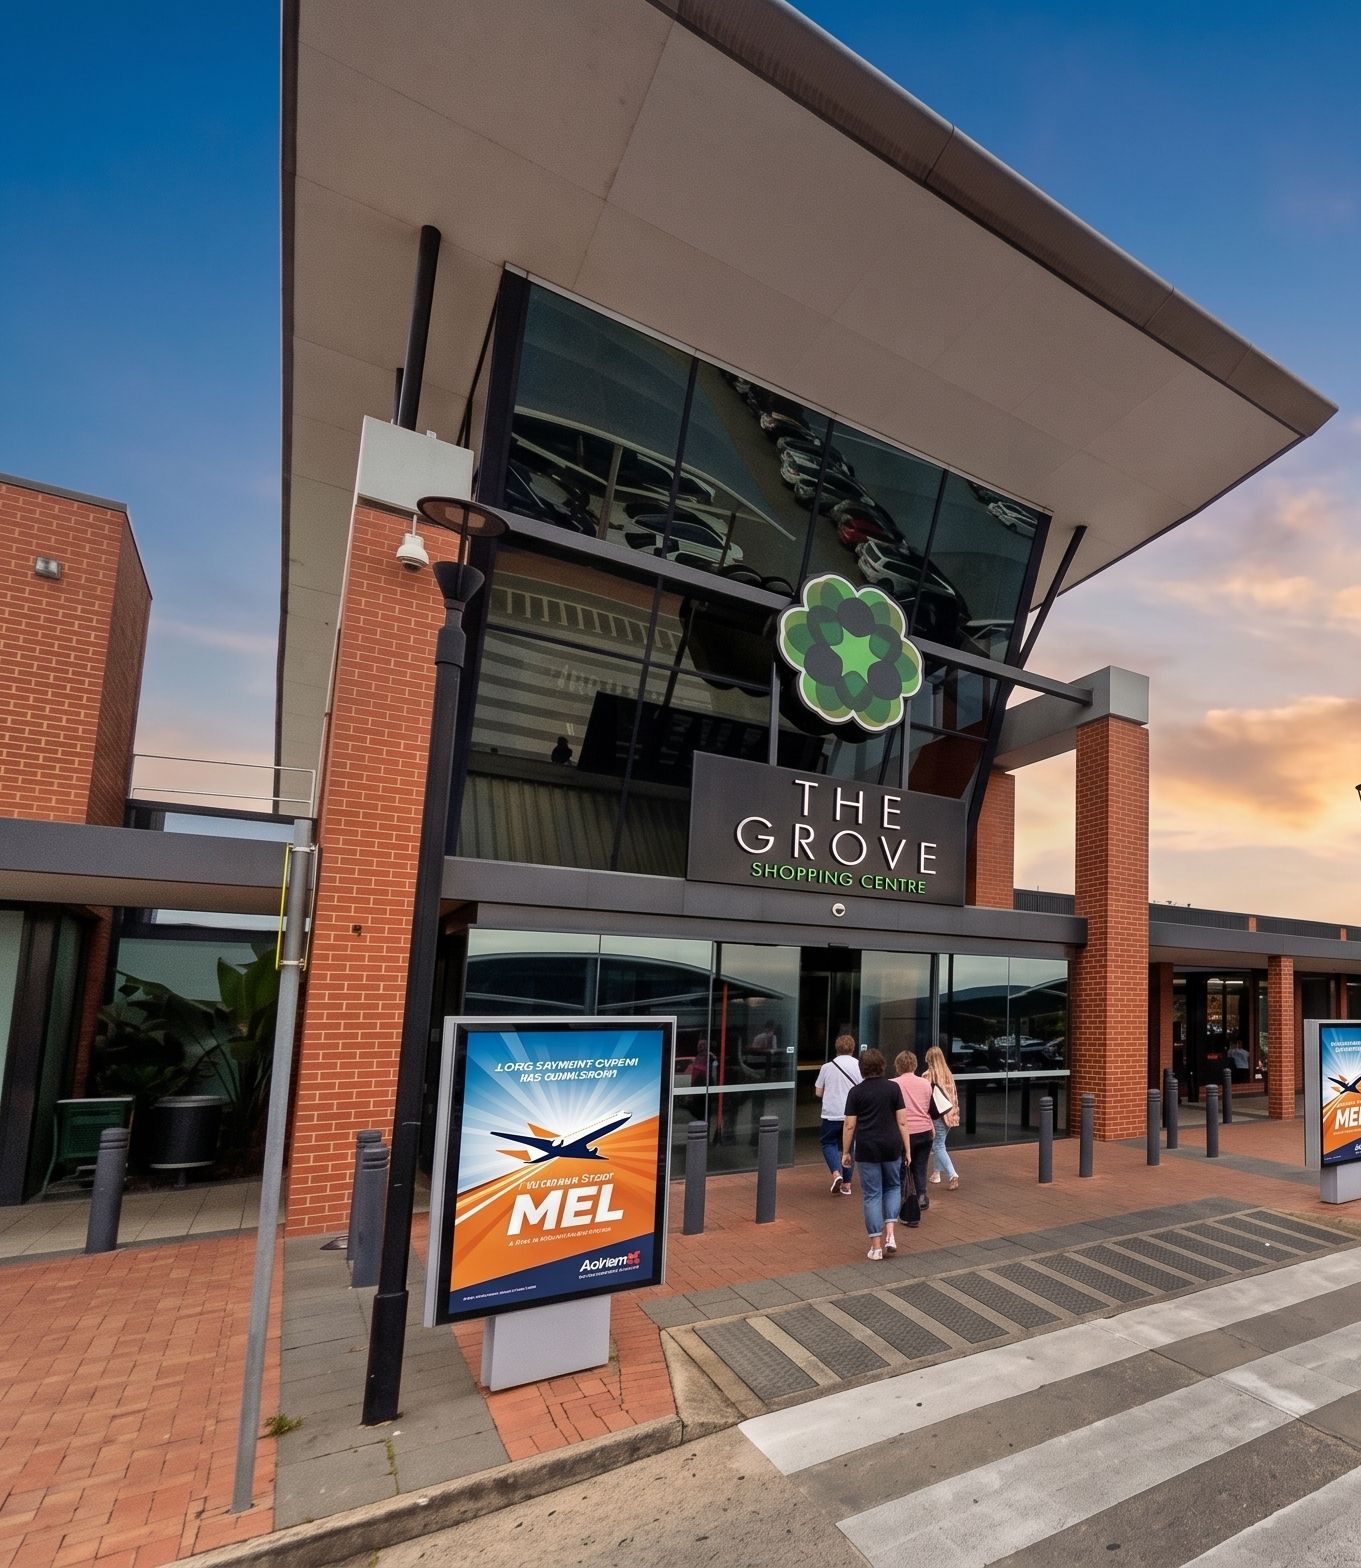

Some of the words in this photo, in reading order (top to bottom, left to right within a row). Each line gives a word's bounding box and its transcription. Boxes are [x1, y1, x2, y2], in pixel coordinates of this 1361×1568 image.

[794, 779, 902, 830] THE
[736, 816, 938, 875] GROVE
[750, 862, 853, 887] SHOPPING
[860, 874, 927, 894] CENTRE
[506, 1183, 624, 1236] MEL
